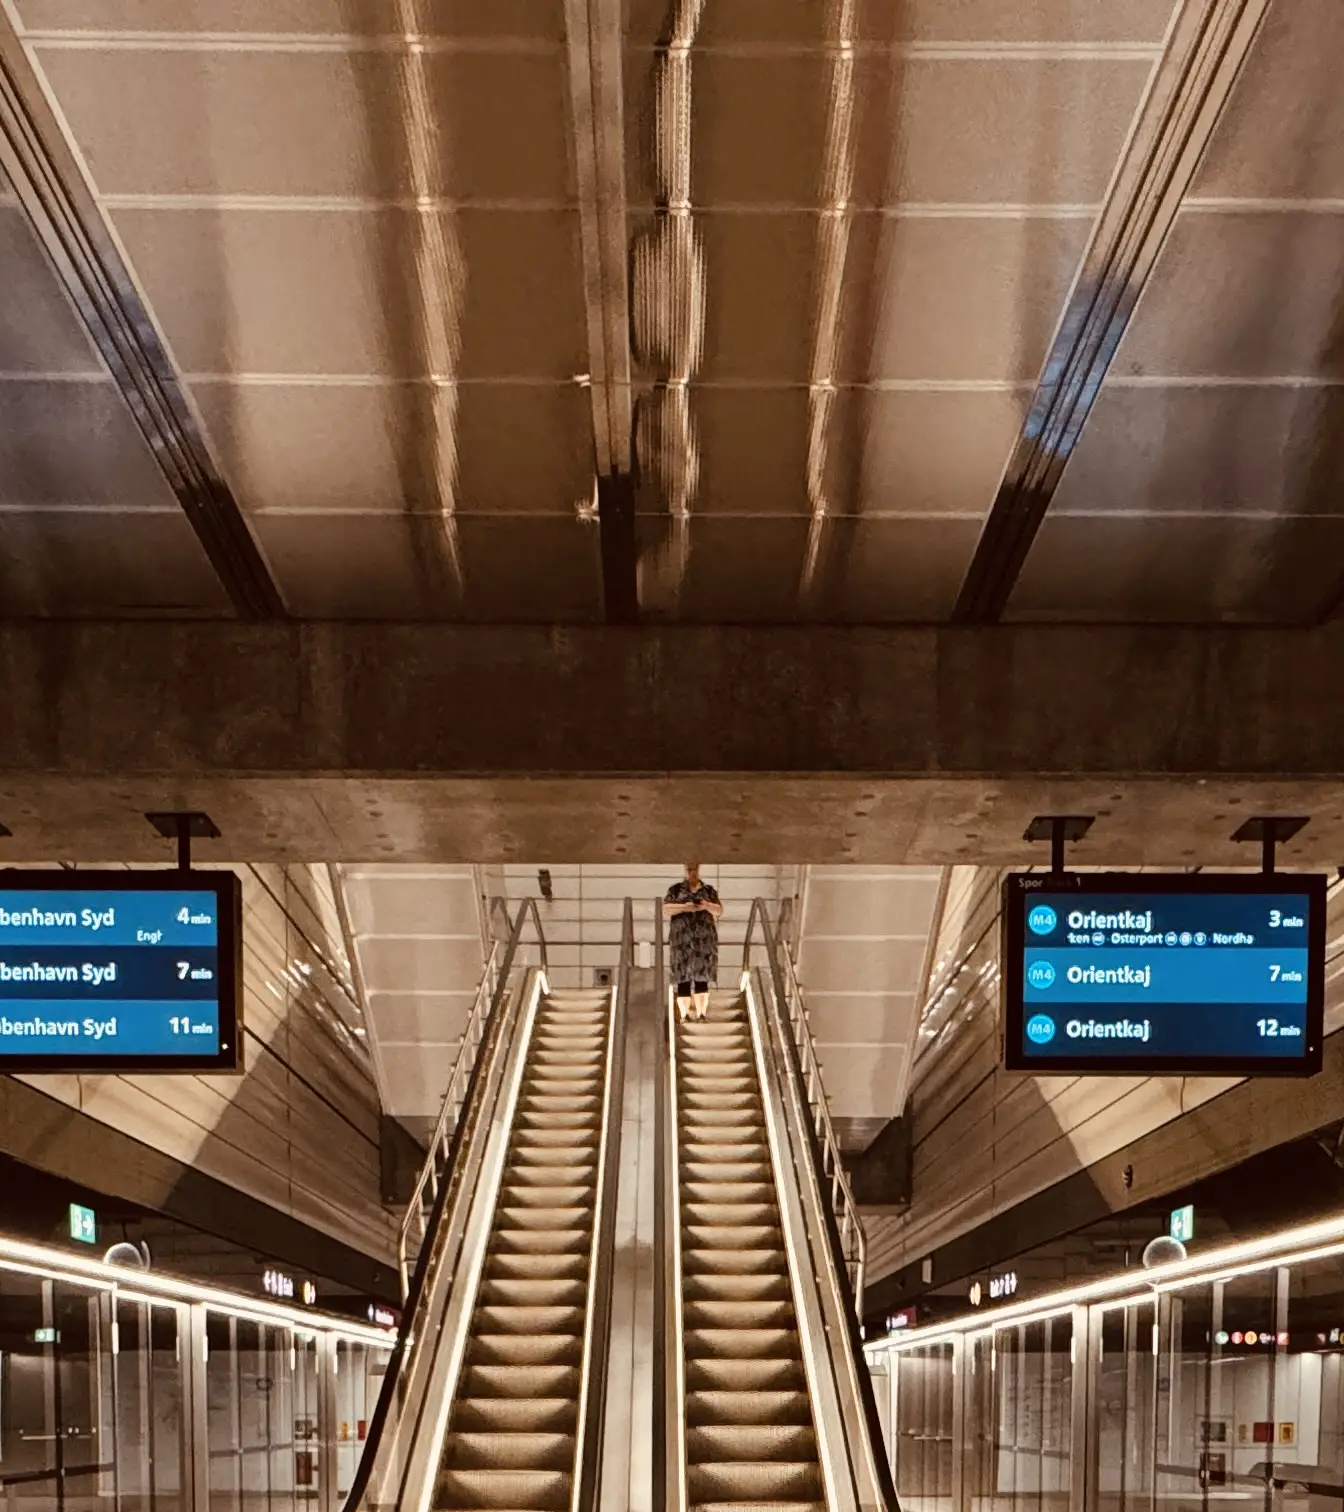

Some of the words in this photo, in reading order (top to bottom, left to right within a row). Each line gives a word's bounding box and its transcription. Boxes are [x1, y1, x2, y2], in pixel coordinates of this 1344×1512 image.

[81, 907, 115, 931] Syd
[177, 907, 190, 925] 4
[191, 914, 212, 925] min
[1033, 914, 1053, 926] M4
[1068, 911, 1152, 933] Orientkaj
[1268, 910, 1281, 928] 3
[1283, 916, 1304, 927] min
[82, 962, 116, 985] Syd
[177, 962, 189, 980] 7
[191, 968, 213, 980] min
[1033, 969, 1053, 980] M4
[1067, 965, 1151, 987] Orientkaj
[1269, 965, 1281, 982] 7
[1282, 971, 1302, 982] min
[83, 1017, 117, 1040] Syd
[169, 1016, 190, 1034] 11
[192, 1022, 213, 1034] min
[1032, 1023, 1052, 1035] M4
[1067, 1019, 1150, 1042] Orientkaj
[1256, 1019, 1279, 1036] 12
[1280, 1025, 1301, 1036] min
